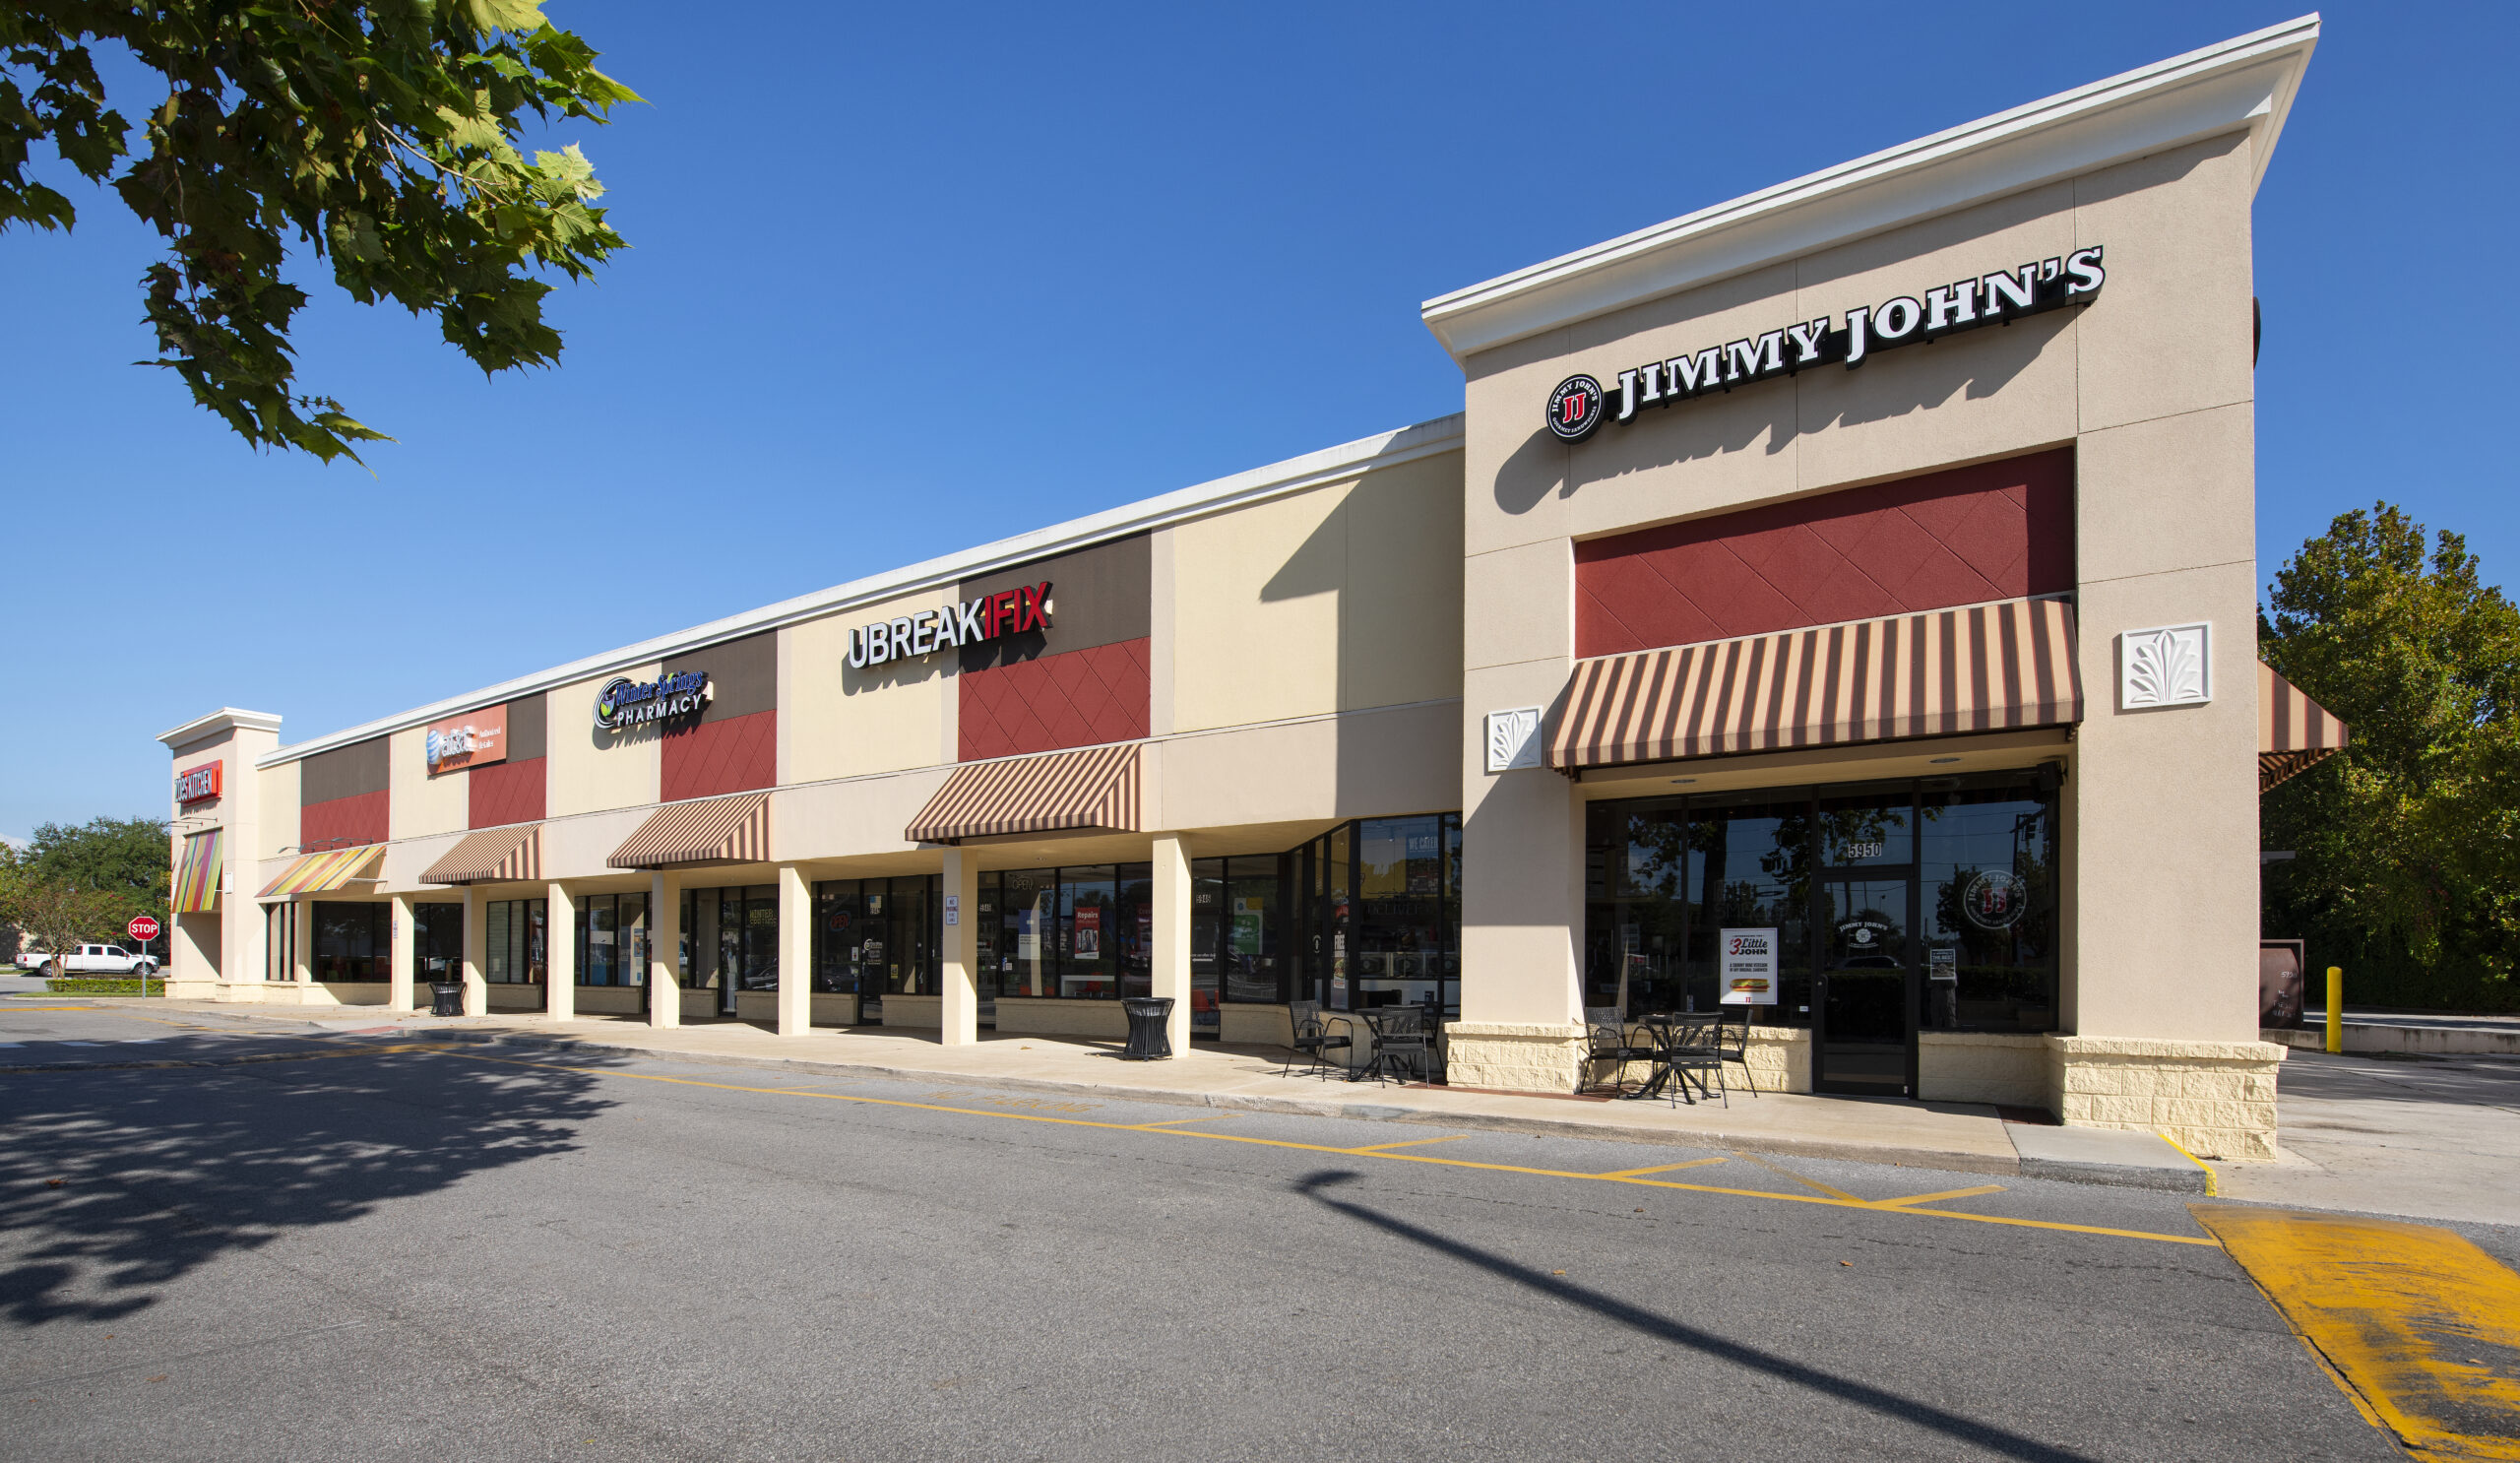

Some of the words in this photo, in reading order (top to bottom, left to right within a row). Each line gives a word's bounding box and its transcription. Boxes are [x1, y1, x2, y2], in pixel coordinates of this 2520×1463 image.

[1617, 316, 1832, 424] JIMMY
[1844, 244, 2106, 367] JOHN'S
[1551, 382, 1573, 413] JIMMY
[1574, 380, 1598, 402] JOHN'S
[1562, 391, 1587, 424] JJ
[1552, 416, 1571, 433] GOURMET
[848, 581, 1050, 668] UBREAKIFIX
[615, 681, 657, 706] Winter
[657, 670, 704, 701] Springs
[617, 693, 702, 727] PHARMACY
[188, 768, 213, 799] KITCHEN
[1850, 843, 1880, 858] 5950
[131, 923, 158, 933] STOP
[1077, 912, 1099, 921] Repairs
[1838, 922, 1862, 933] JIMMY
[1863, 922, 1889, 931] JOHN'S
[1740, 937, 1768, 948] Little
